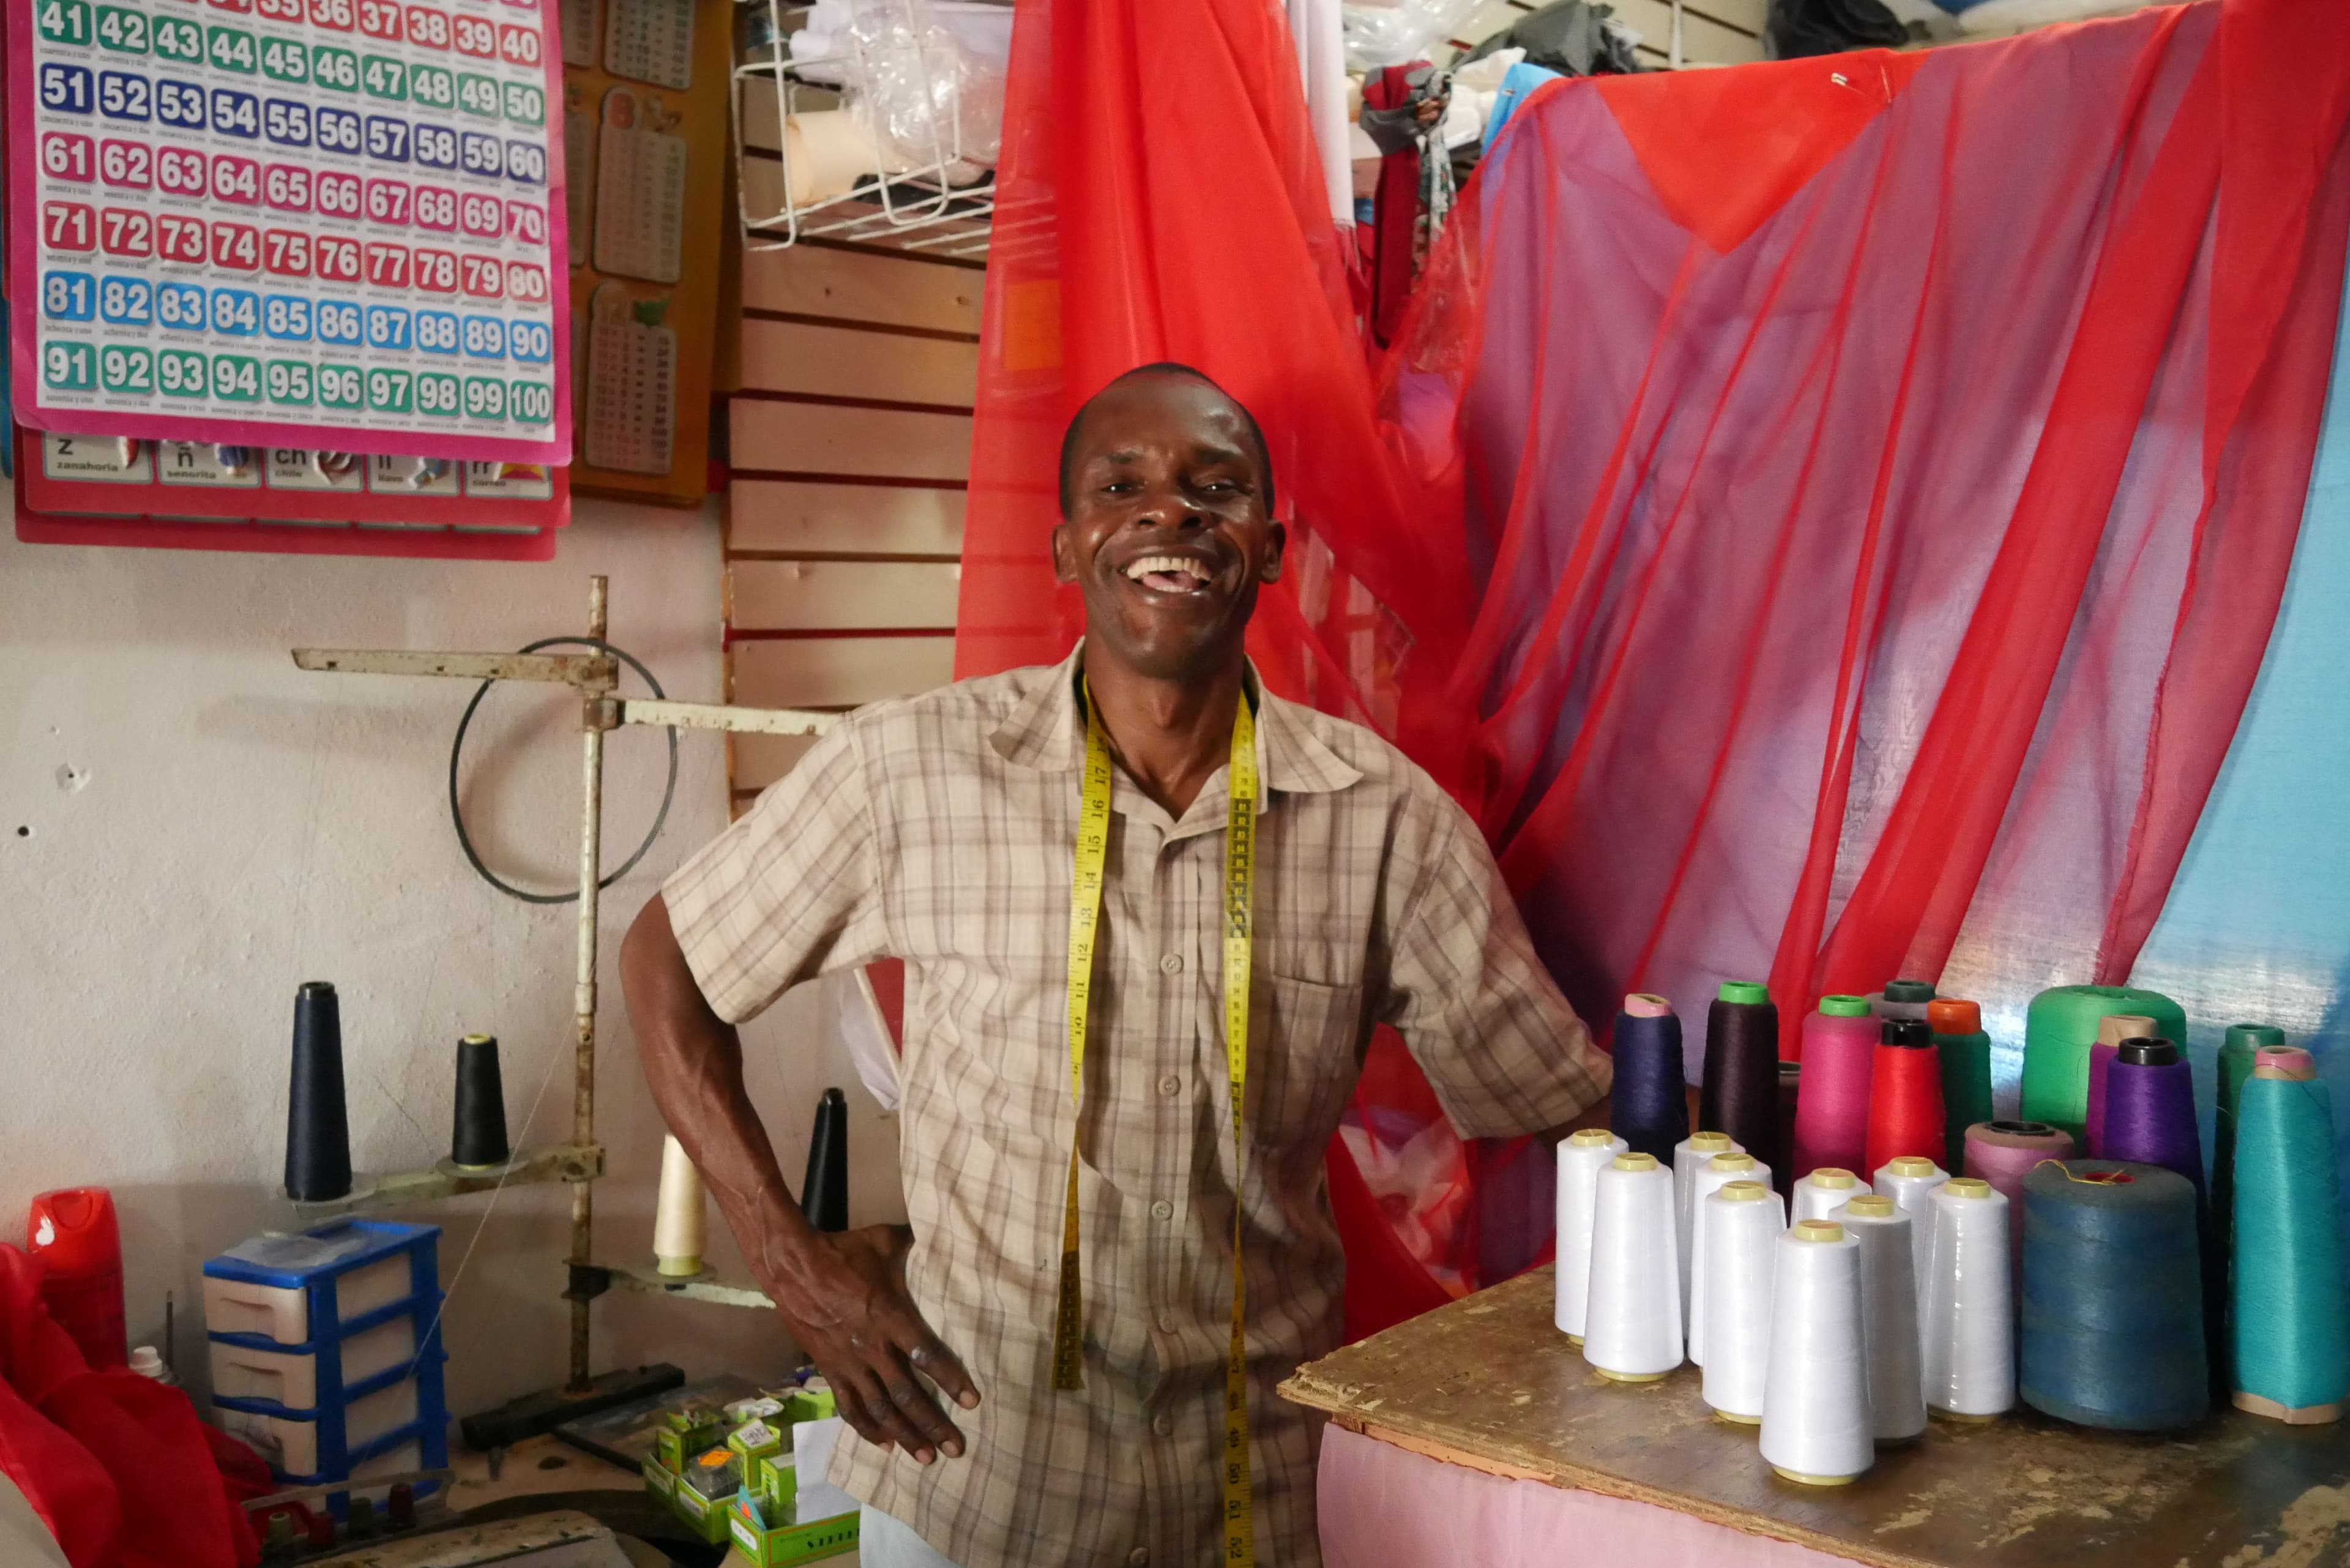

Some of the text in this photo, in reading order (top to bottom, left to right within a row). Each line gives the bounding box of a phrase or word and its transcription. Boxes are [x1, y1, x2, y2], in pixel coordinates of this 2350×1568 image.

[313, 0, 352, 26] 36
[362, 1, 398, 35] 37
[410, 10, 447, 45] 38
[457, 20, 494, 54] 39
[503, 29, 540, 62] 40
[42, 1, 83, 39] 41
[100, 11, 146, 49] 42
[157, 22, 201, 58] 43
[211, 33, 254, 69] 44
[264, 43, 308, 78] 45
[316, 51, 357, 87] 46
[366, 61, 403, 94] 47
[414, 70, 452, 103] 48
[461, 78, 497, 111] 49
[506, 86, 542, 121] 50
[43, 69, 84, 107] 51
[103, 77, 149, 116] 52
[160, 84, 203, 123] 53
[215, 94, 257, 133] 54
[267, 103, 308, 141] 55
[319, 112, 359, 151] 56
[369, 120, 407, 157] 57
[418, 129, 455, 165] 58
[464, 136, 500, 172] 59
[509, 144, 543, 181] 60
[46, 138, 86, 175] 61
[105, 145, 148, 183] 62
[161, 153, 203, 190] 63
[215, 160, 257, 199] 64
[267, 169, 308, 206] 65
[320, 177, 358, 212] 66
[370, 184, 407, 218] 67
[419, 191, 453, 225] 68
[465, 198, 499, 232] 69
[509, 207, 542, 239] 70
[48, 206, 86, 244] 71
[106, 214, 149, 250] 72
[162, 220, 202, 256] 73
[216, 227, 255, 264] 74
[269, 235, 307, 270] 75
[320, 241, 357, 275] 76
[370, 247, 406, 281] 77
[419, 253, 455, 287] 78
[465, 259, 501, 293] 79
[510, 266, 545, 298] 80
[47, 277, 548, 357] 81 82 83 84 85 86 87 88 89 90
[47, 347, 550, 419] 91 92 93 94 95 96 97 98 99 100
[57, 461, 118, 472] zanahoria
[177, 446, 193, 468] ñ
[1094, 766, 1106, 785] 17
[1091, 799, 1104, 818] 16
[1087, 835, 1100, 854] 15
[1084, 872, 1096, 889] 14
[1080, 907, 1092, 927] 13
[1077, 944, 1088, 962] 12
[1075, 982, 1084, 999] 11
[1075, 1017, 1082, 1034] 10
[1229, 1463, 1240, 1484] 50
[1229, 1500, 1241, 1521] 51
[1230, 1537, 1242, 1559] 52
